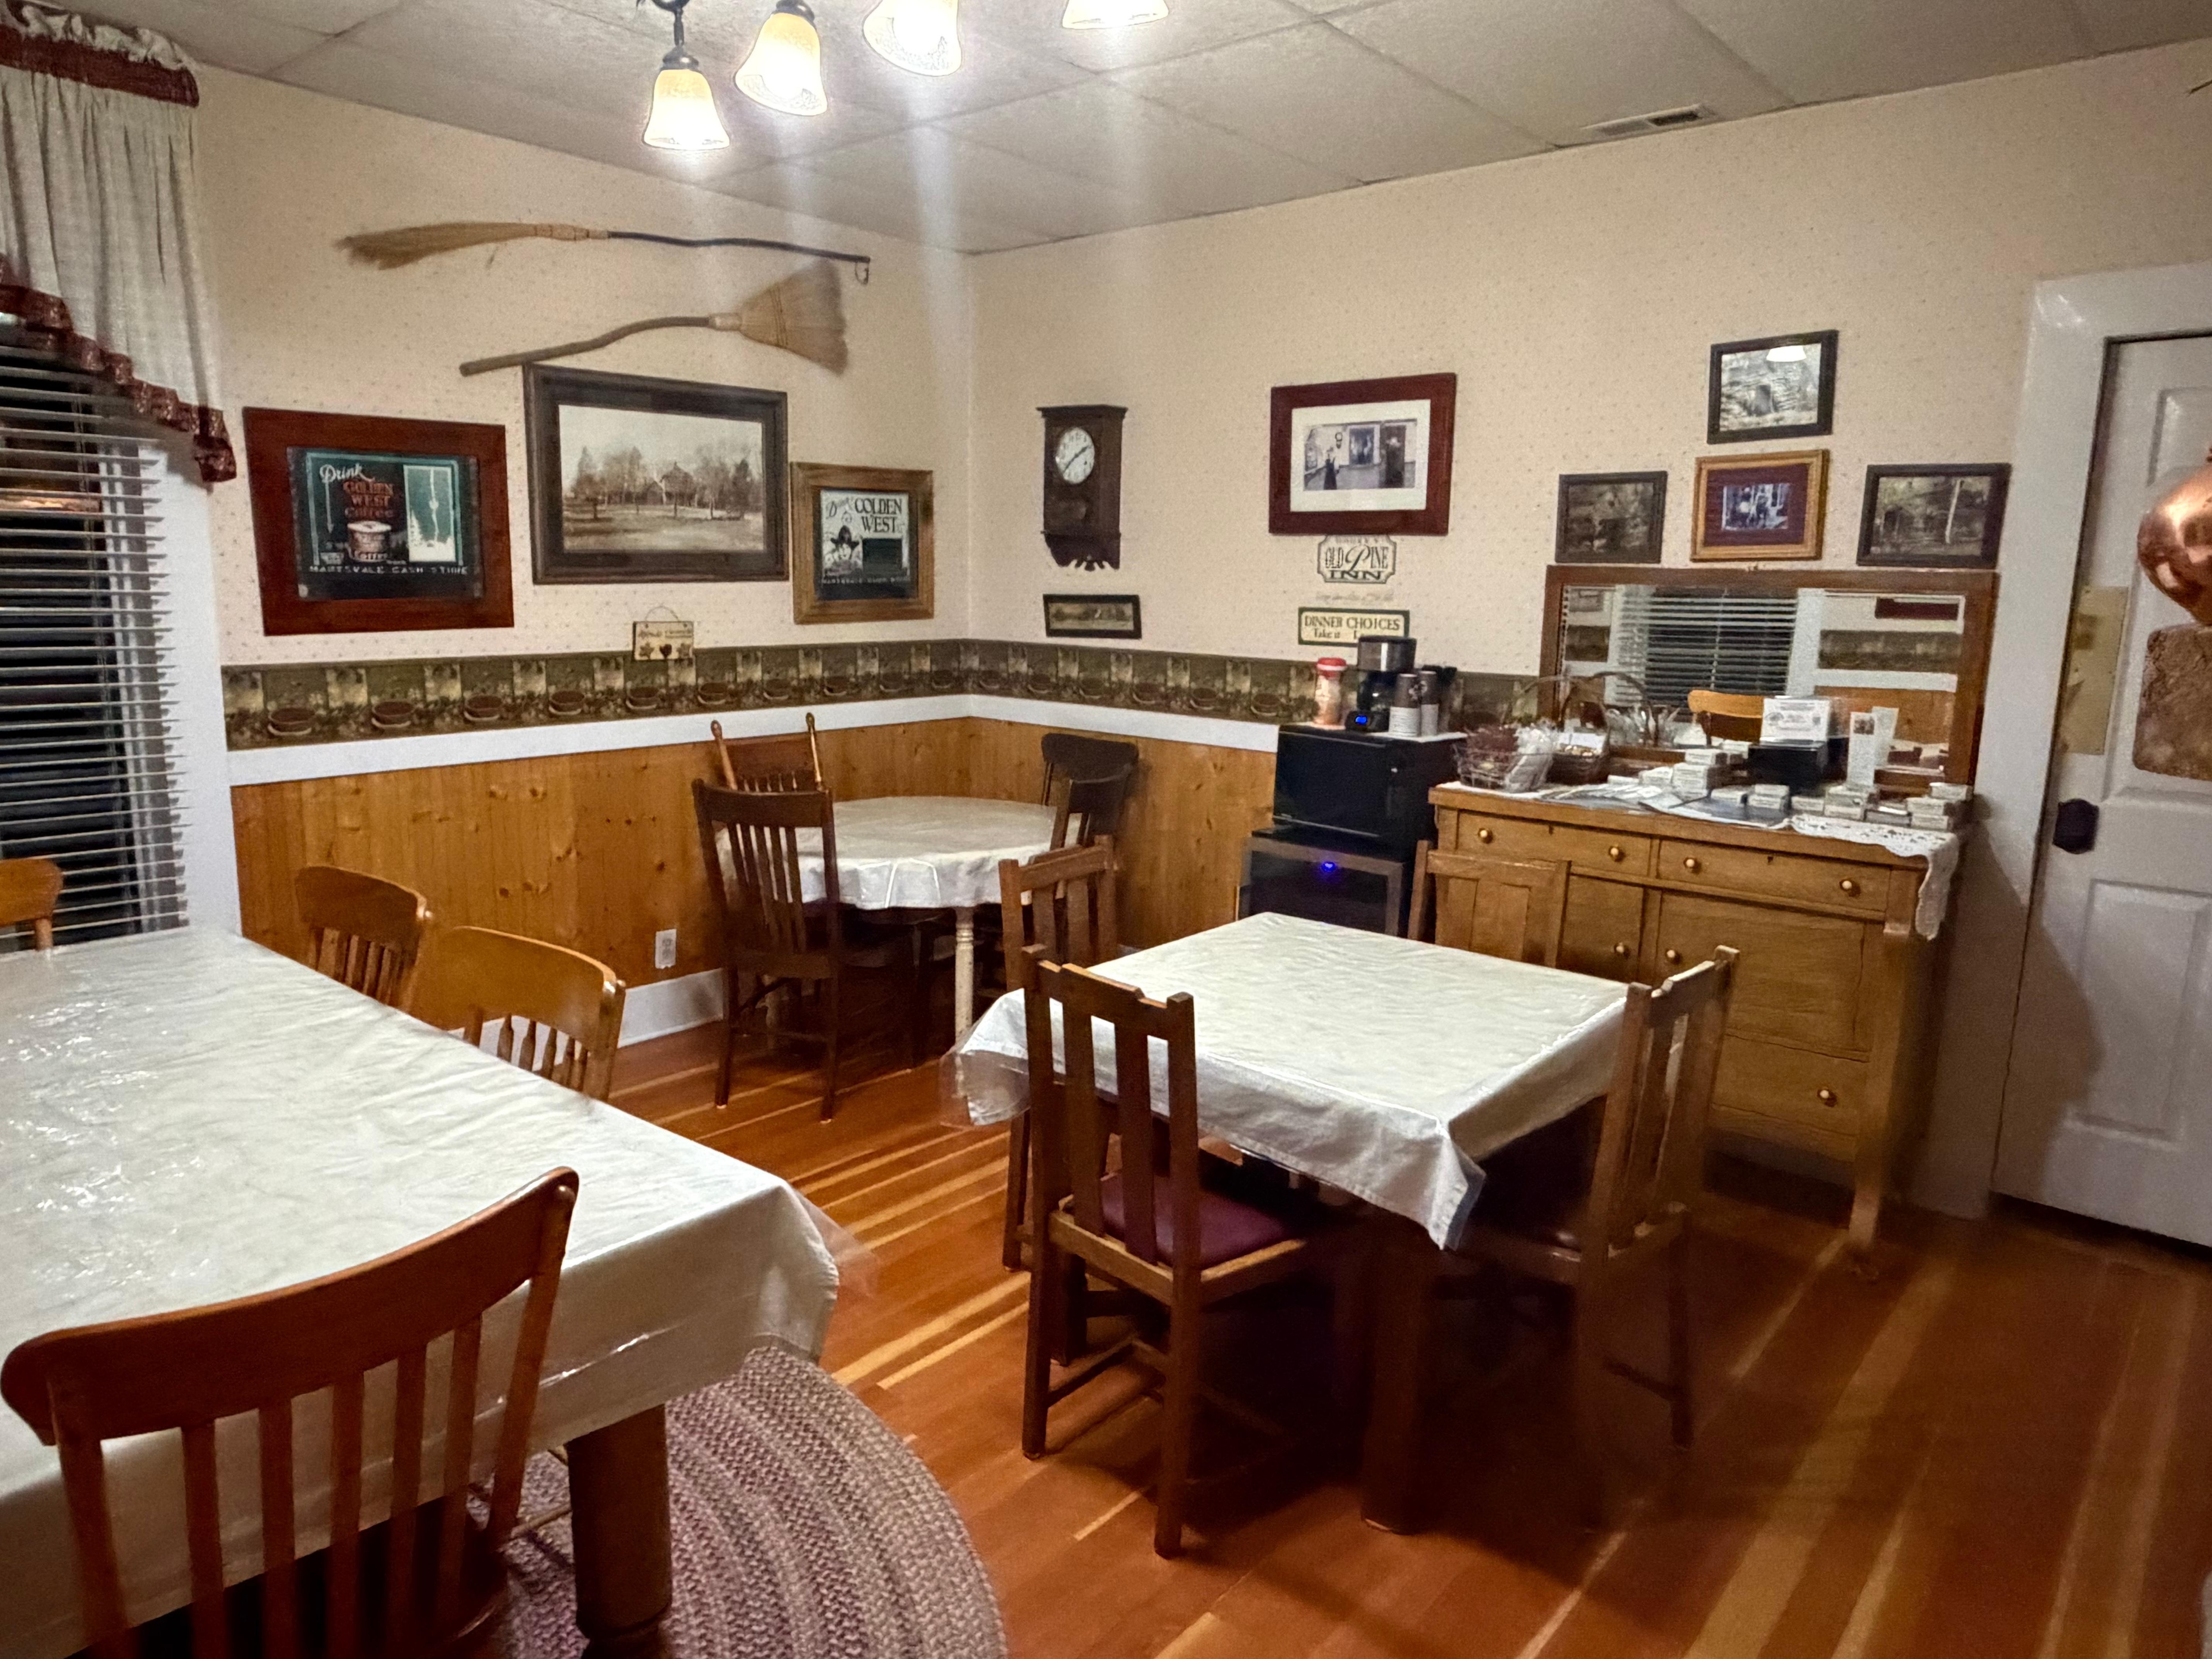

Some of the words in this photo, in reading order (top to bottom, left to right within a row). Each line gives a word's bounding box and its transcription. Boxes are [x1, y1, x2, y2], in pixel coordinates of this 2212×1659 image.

[319, 463, 376, 483] Drink
[861, 515, 897, 534] WEST
[1325, 547, 1344, 568] OLD
[1327, 569, 1382, 580] INN
[1305, 615, 1343, 628] DINNER
[1346, 617, 1401, 631] CHOICES
[1314, 628, 1332, 638] Take
